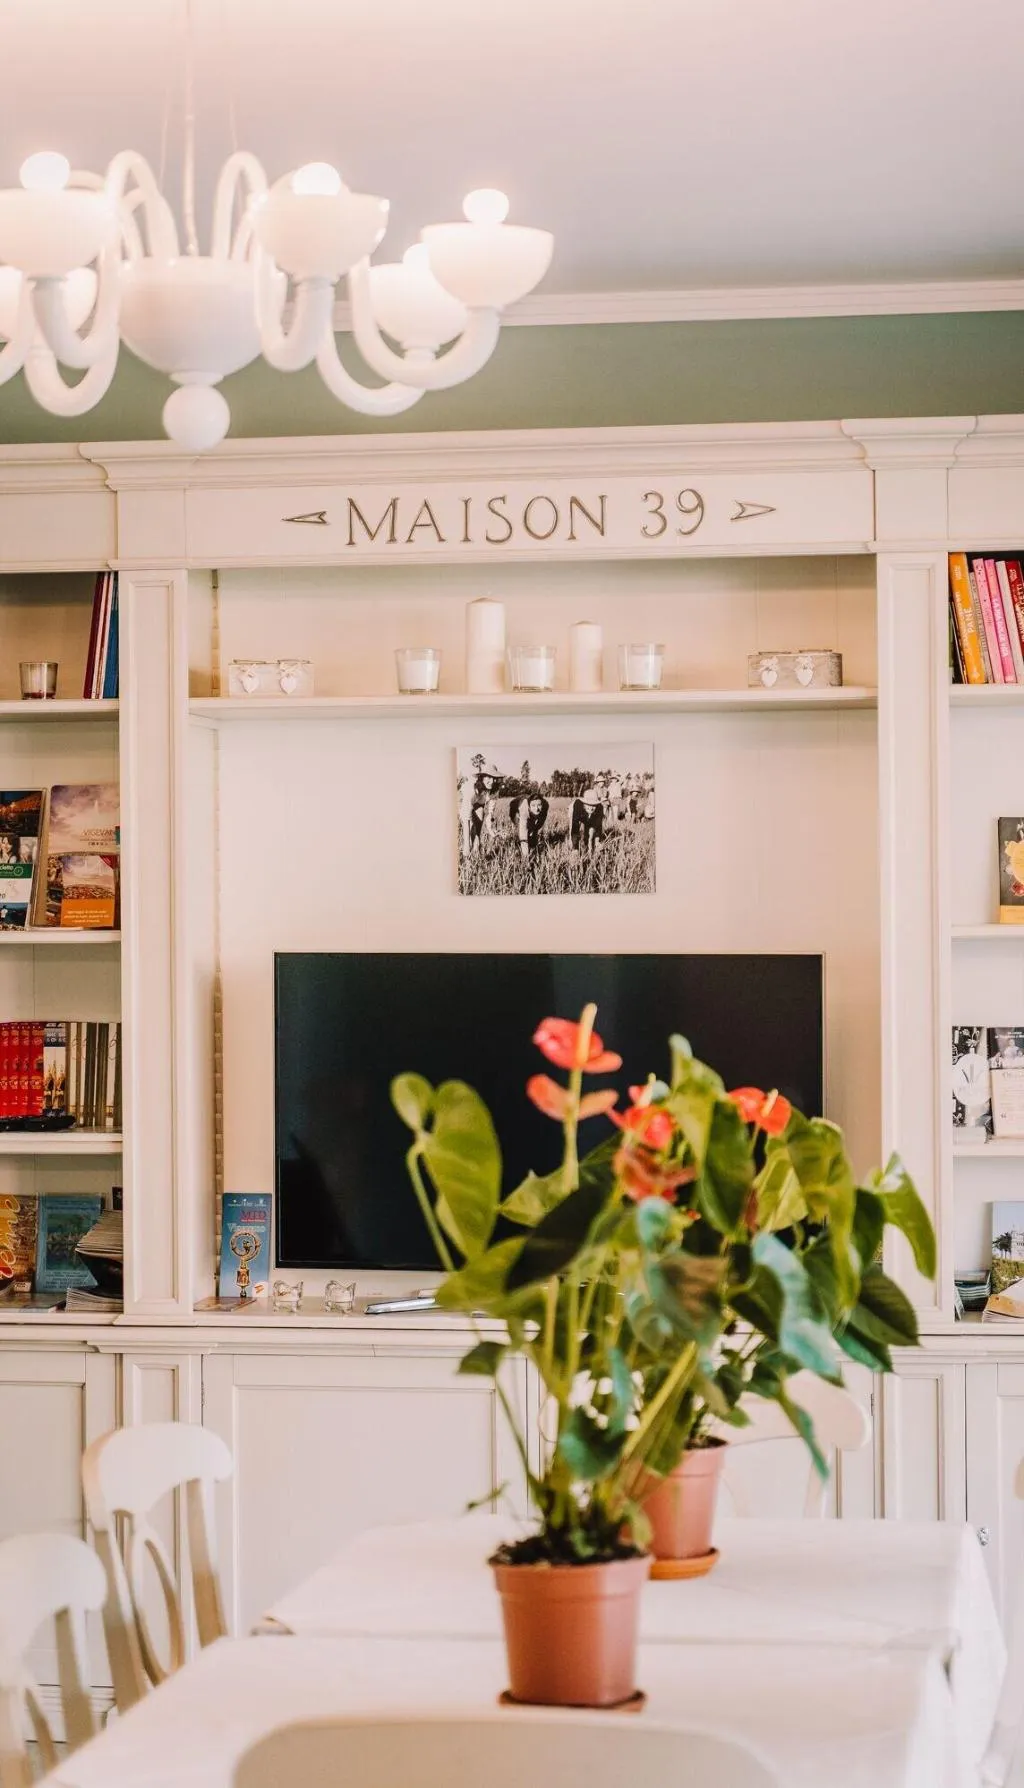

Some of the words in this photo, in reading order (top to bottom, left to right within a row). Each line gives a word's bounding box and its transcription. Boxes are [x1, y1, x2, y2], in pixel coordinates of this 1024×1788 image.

[345, 494, 608, 546] MAISON
[640, 488, 705, 538] 39
[963, 608, 976, 633] PANE
